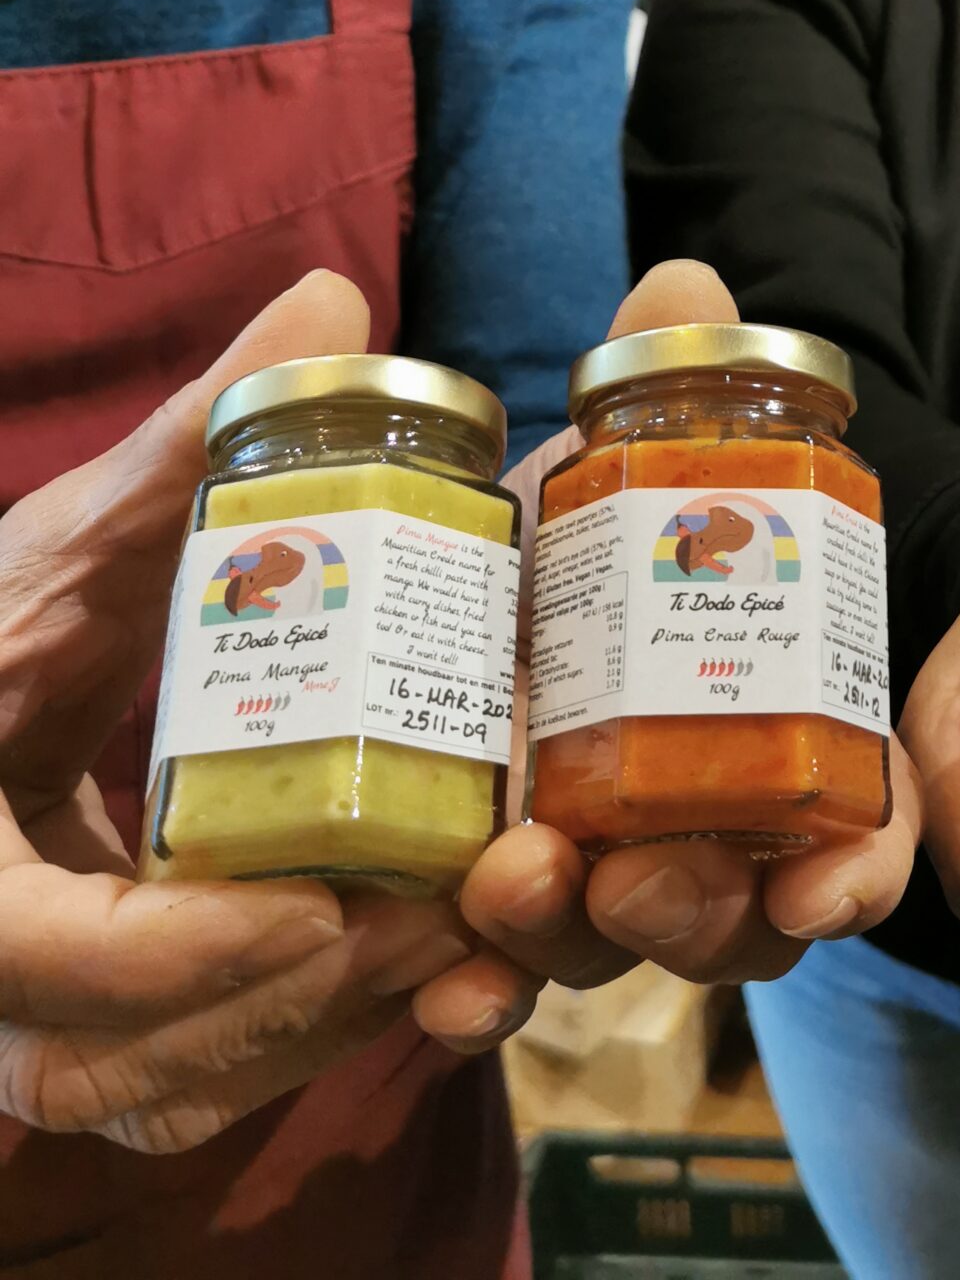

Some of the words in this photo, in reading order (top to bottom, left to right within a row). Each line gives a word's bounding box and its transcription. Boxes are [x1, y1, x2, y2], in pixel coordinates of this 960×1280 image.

[382, 538, 426, 557] Mauritian
[430, 551, 455, 565] Creole
[458, 562, 481, 572] name
[484, 564, 495, 577] for
[461, 544, 468, 552] is
[471, 546, 483, 558] the
[396, 556, 417, 571] fresh
[421, 565, 441, 578] chilli
[444, 573, 466, 584] paste
[470, 580, 488, 591] with
[385, 590, 405, 601] with
[408, 597, 430, 613] curry
[464, 607, 486, 621] fried
[418, 579, 430, 591] We
[433, 586, 457, 598] would
[460, 592, 479, 604] have
[482, 598, 489, 607] it
[670, 592, 688, 611] Ti
[689, 593, 735, 611] Dodo
[741, 592, 785, 617] Epicé
[374, 602, 408, 619] chicken
[422, 612, 438, 626] fish
[441, 621, 458, 631] and
[461, 628, 474, 638] you
[478, 632, 492, 640] can
[214, 633, 234, 653] Ti
[233, 630, 278, 651] Dodo
[284, 623, 329, 651] Epicé
[395, 624, 408, 636] Or
[411, 632, 424, 640] eat
[427, 634, 434, 642] it
[438, 638, 456, 649] with
[651, 628, 694, 645] Pima
[757, 627, 800, 649] Rouge
[416, 650, 438, 660] won't
[204, 670, 251, 689] Pima
[261, 662, 328, 682] Mangue
[371, 656, 386, 665] Ten
[389, 660, 415, 672] minste
[418, 665, 454, 681] houdbaar
[457, 676, 467, 684] tot
[481, 682, 495, 690] met
[710, 683, 740, 701] 100g
[366, 703, 382, 712] LOT
[245, 720, 275, 736] 100g
